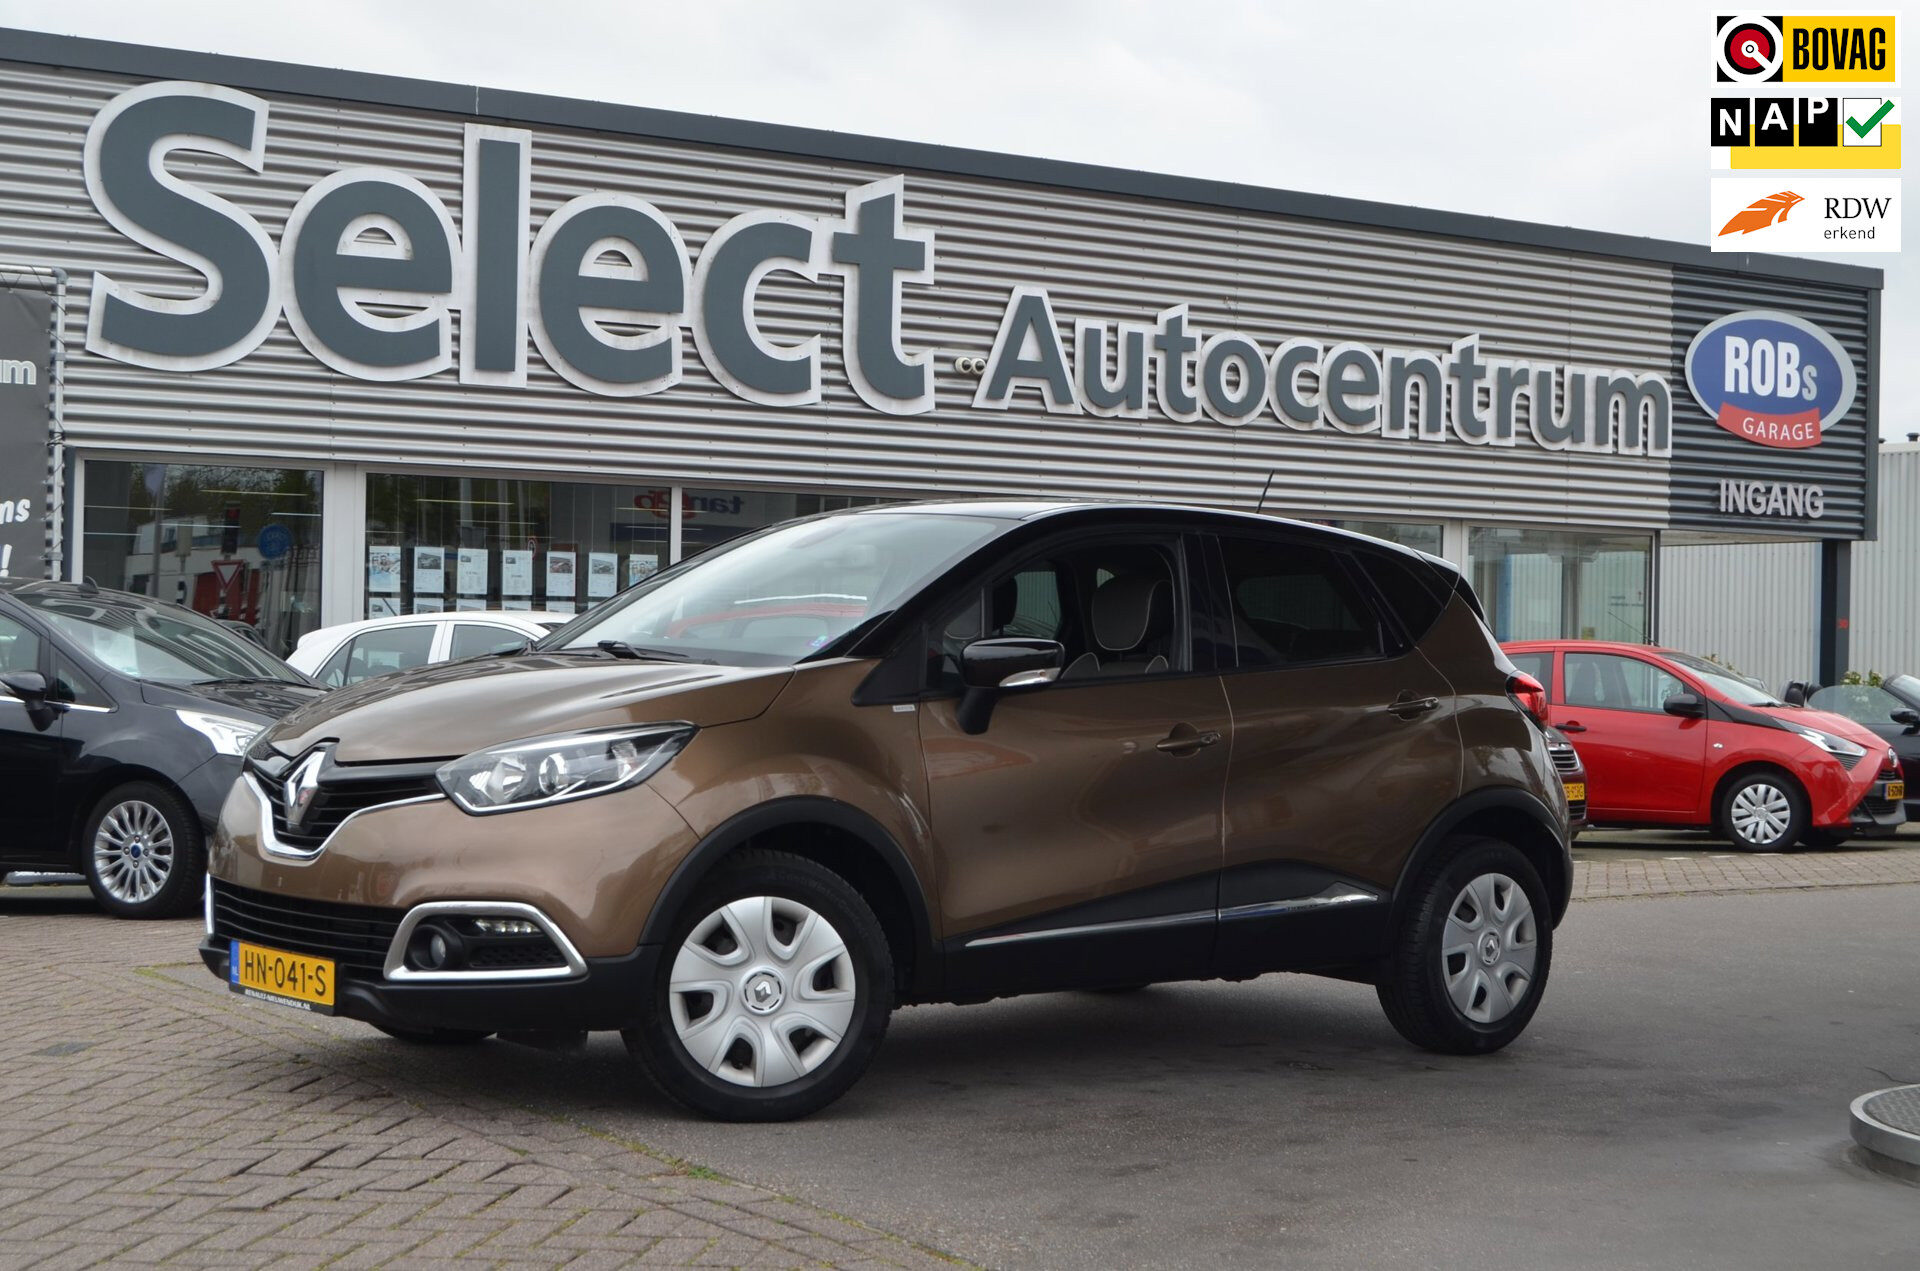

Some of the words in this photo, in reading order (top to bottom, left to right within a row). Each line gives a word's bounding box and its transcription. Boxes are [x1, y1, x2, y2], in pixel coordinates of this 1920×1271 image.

[83, 80, 936, 416] Select
[972, 285, 1674, 458] Autocentrum
[1743, 417, 1814, 441] GARAGE
[1719, 478, 1824, 518] INGANG
[245, 950, 326, 996] HN-041-S
